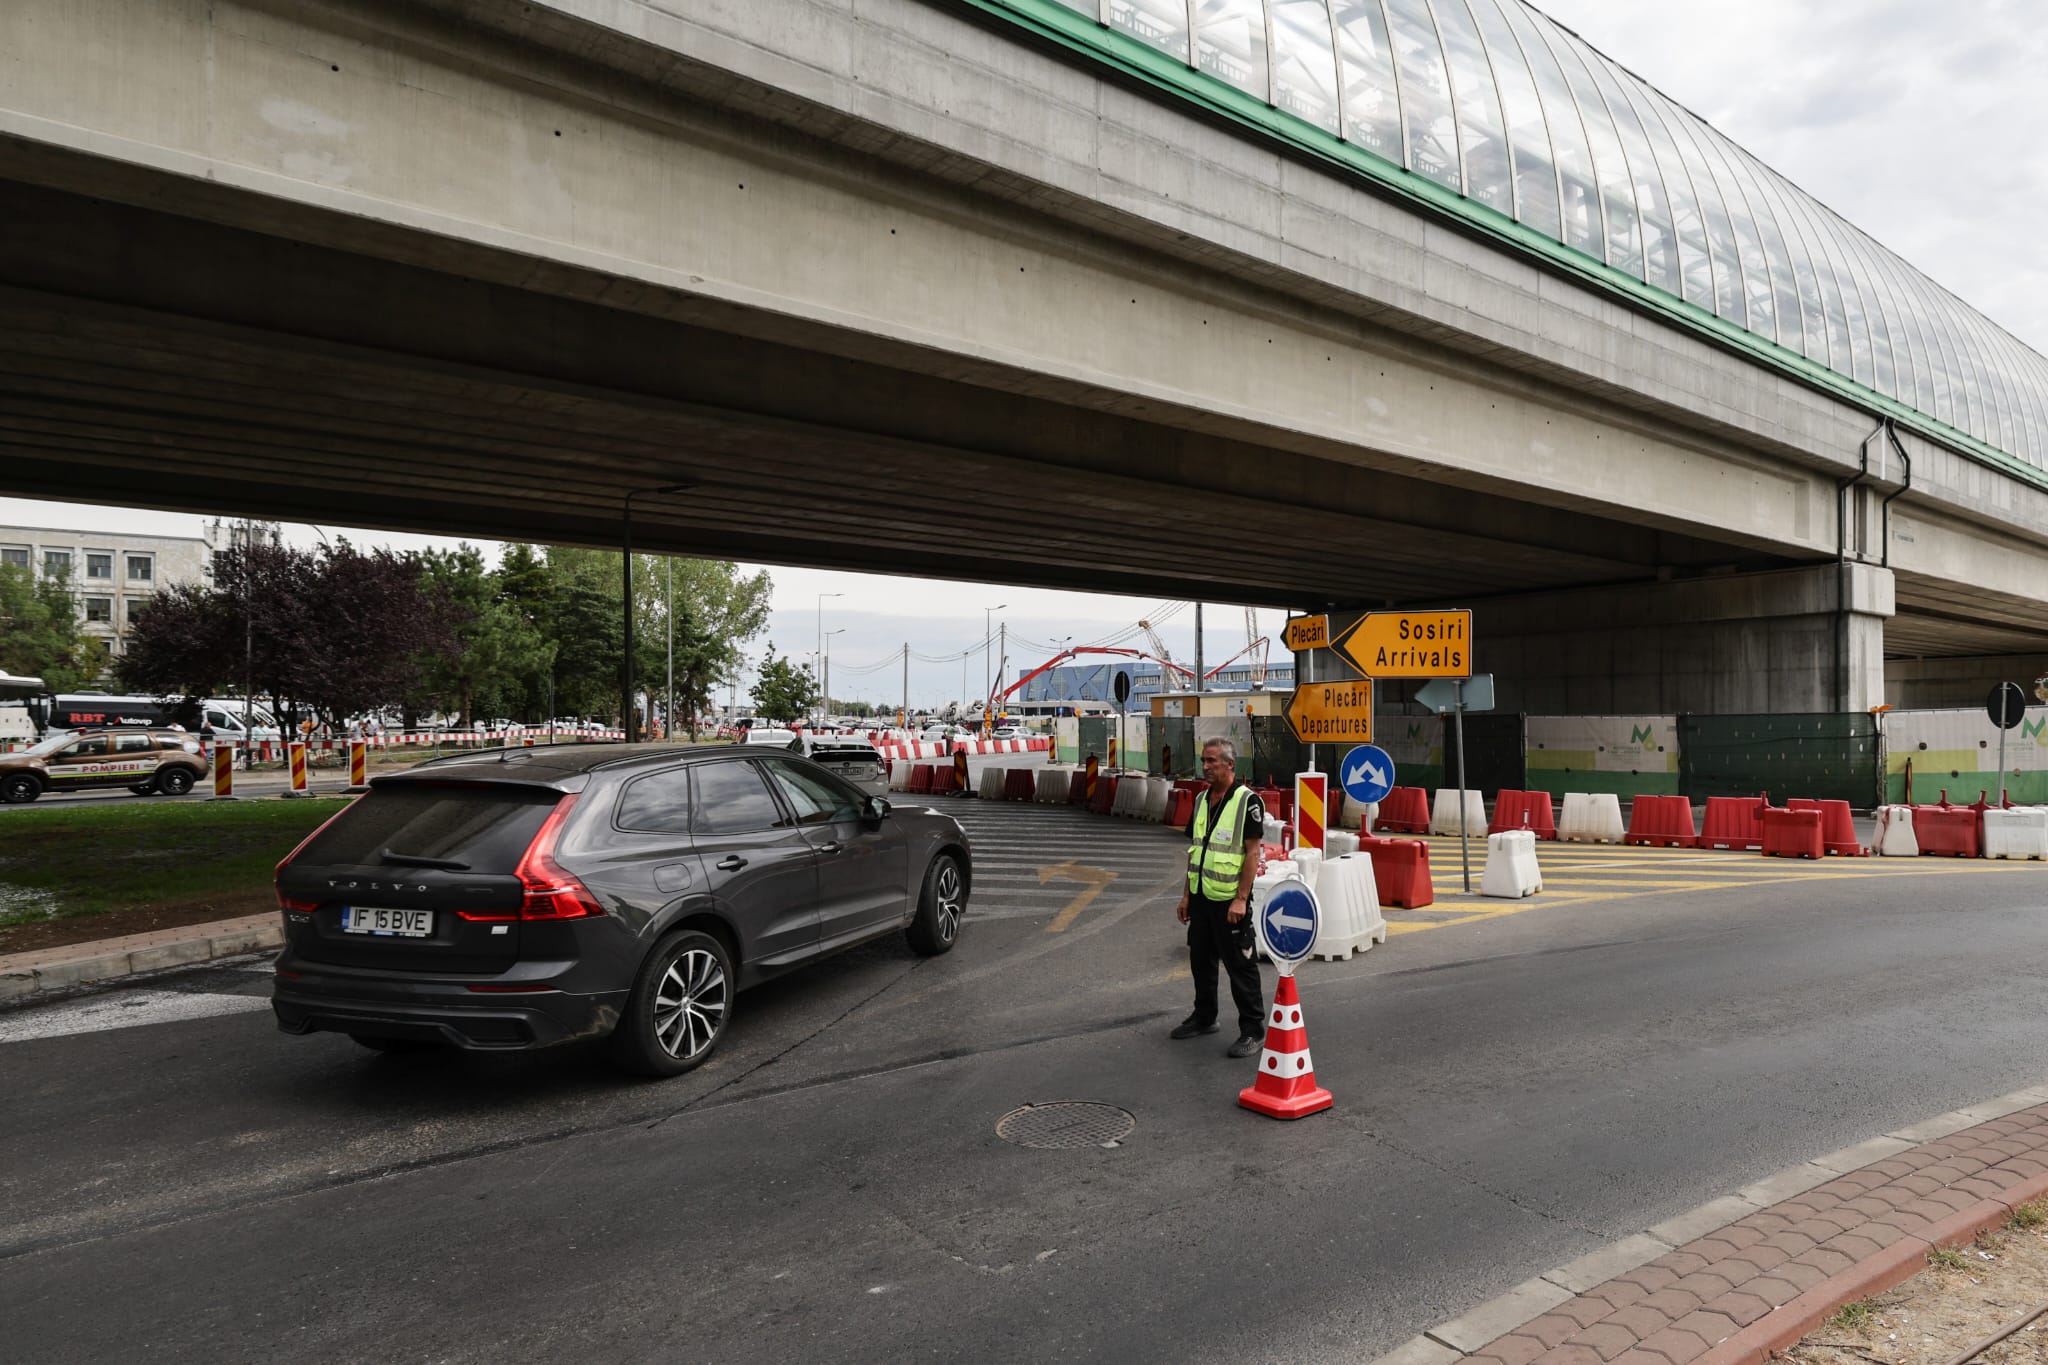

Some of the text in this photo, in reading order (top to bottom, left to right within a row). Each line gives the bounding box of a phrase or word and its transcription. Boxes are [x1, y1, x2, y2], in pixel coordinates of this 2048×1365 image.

[1291, 621, 1325, 645] Plecări
[1399, 618, 1462, 640] Sosiri
[1376, 646, 1462, 668] Arrivals
[1324, 687, 1368, 708] Plecări
[70, 713, 105, 723] RBT
[1301, 714, 1368, 738] Departures
[82, 764, 140, 773] POMPIERI
[328, 880, 427, 892] VOLVO
[353, 908, 370, 927] IF
[374, 910, 389, 929] 15
[391, 911, 427, 931] BVE
